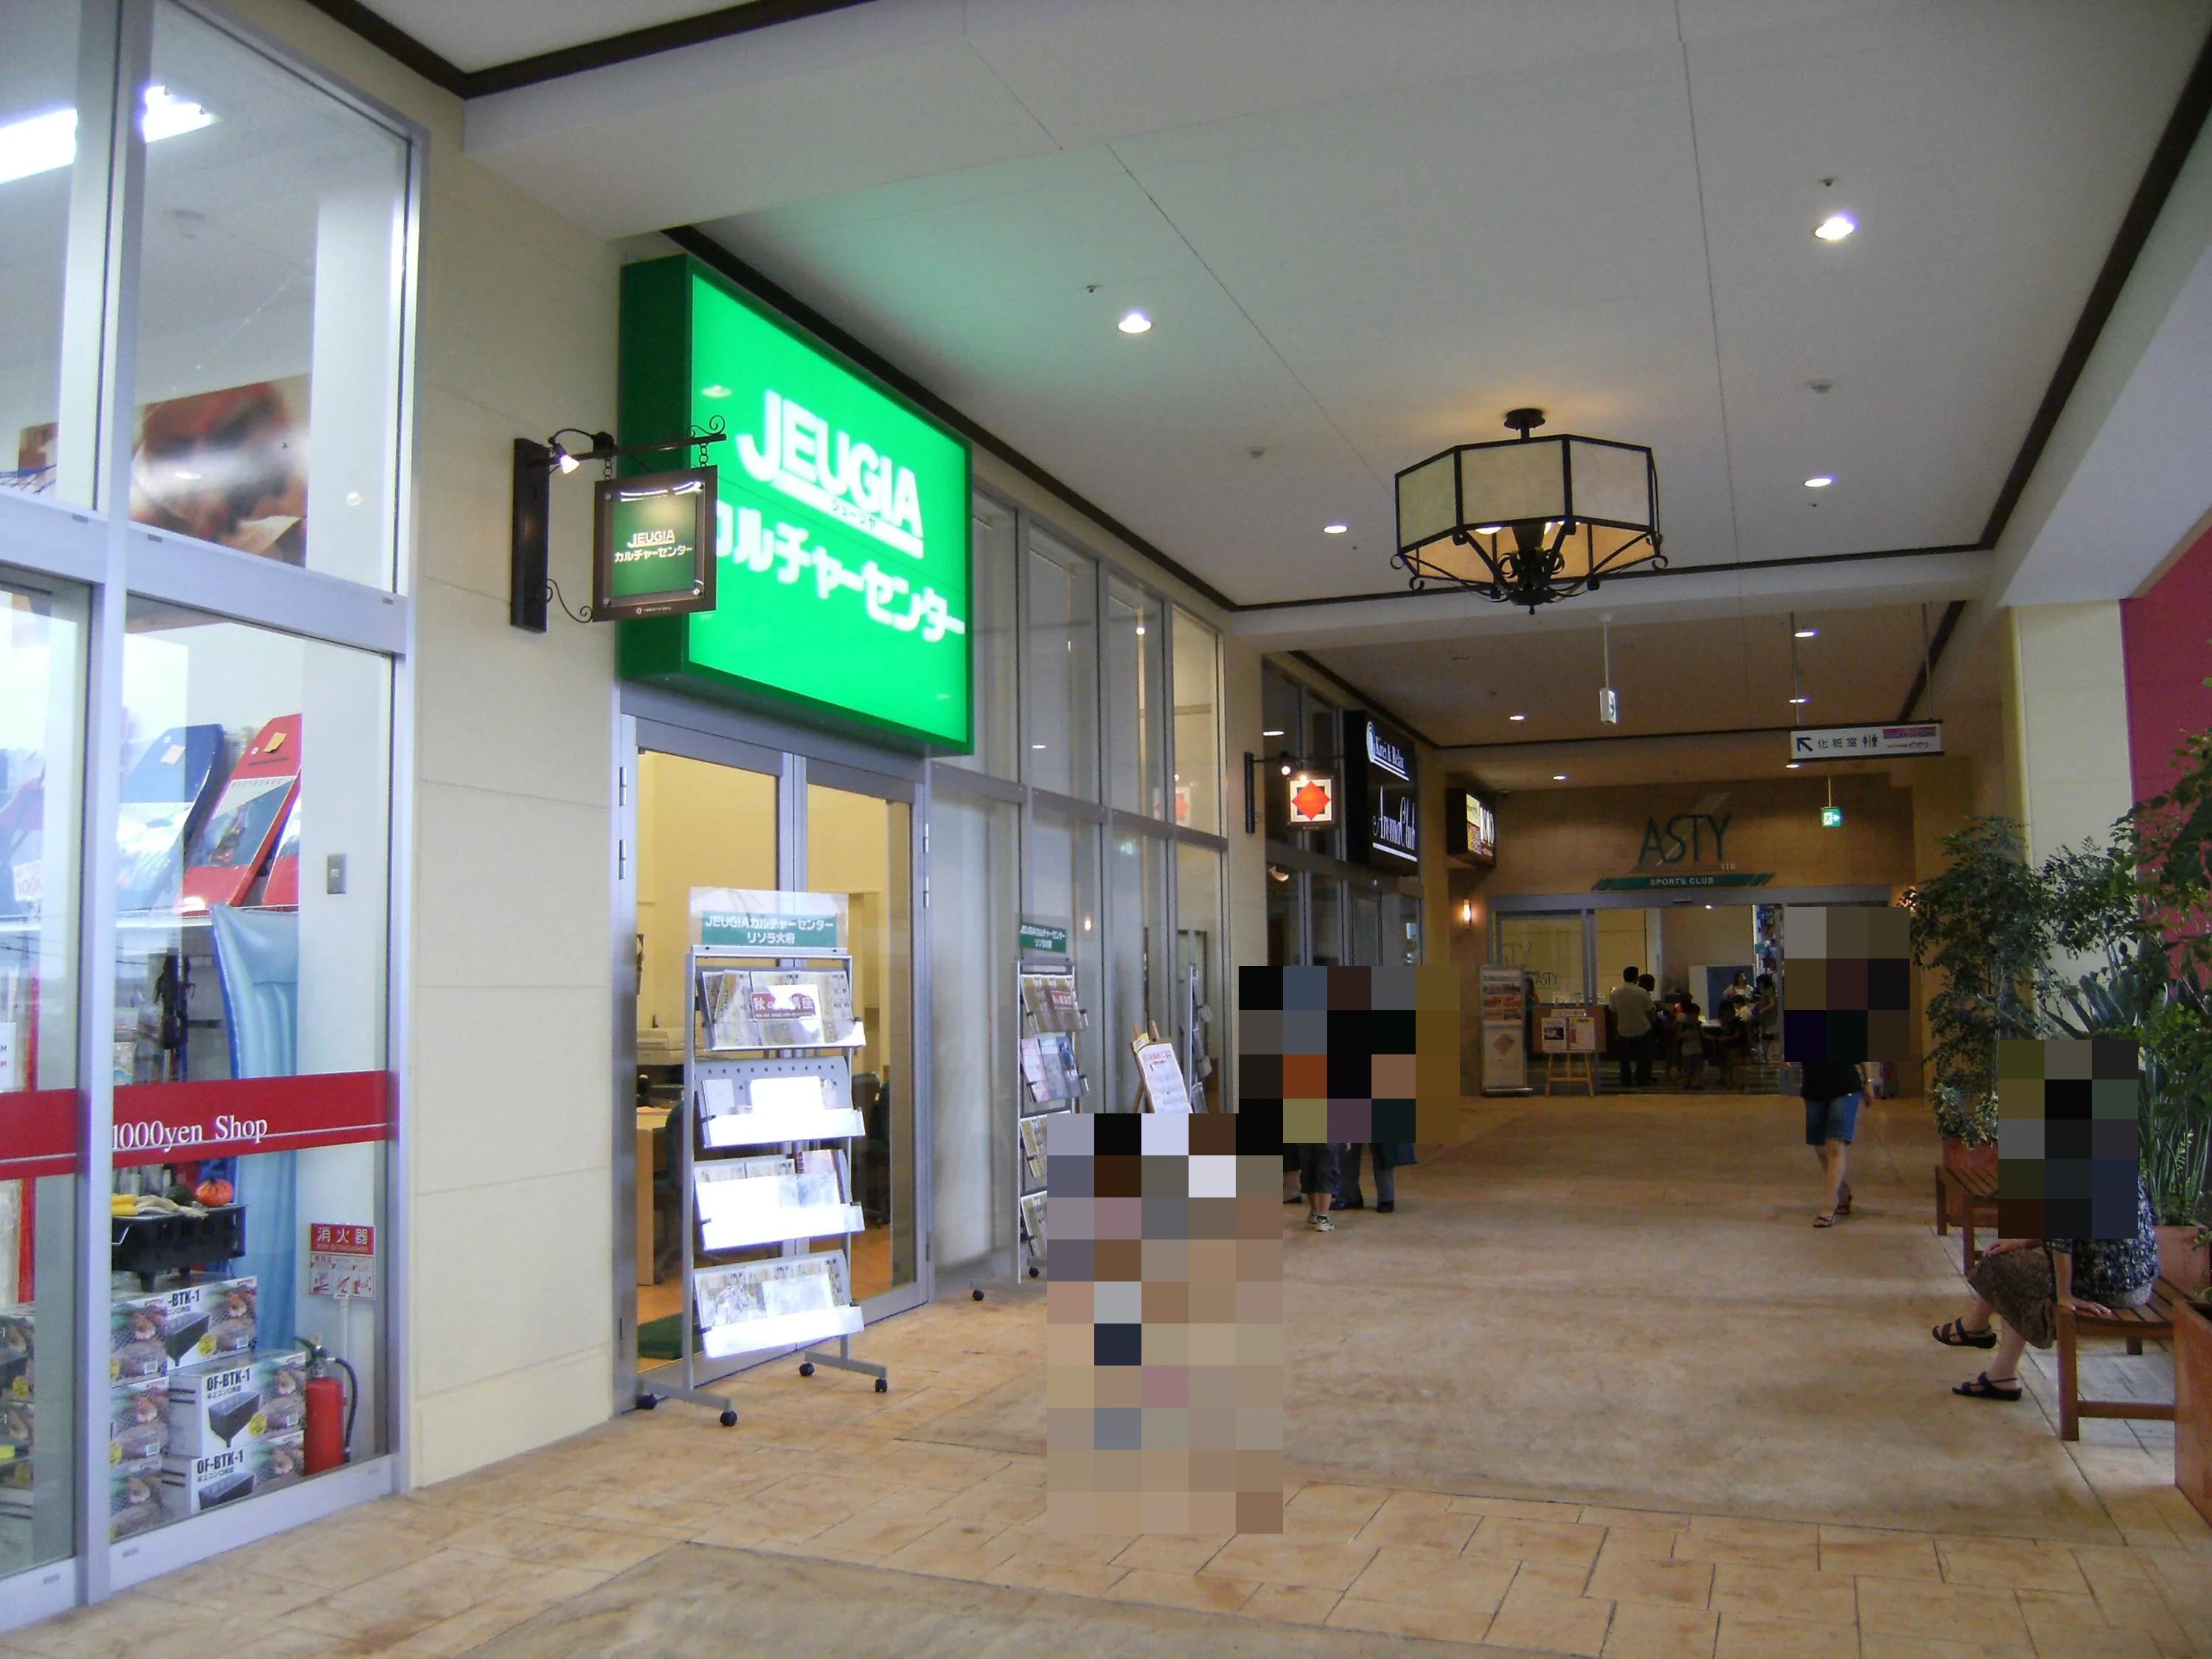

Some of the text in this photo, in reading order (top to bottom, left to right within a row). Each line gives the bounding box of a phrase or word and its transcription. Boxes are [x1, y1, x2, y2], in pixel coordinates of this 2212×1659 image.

[736, 390, 923, 542] JEUGIA
[627, 529, 675, 548] JEUGIA
[614, 546, 693, 563] カルチャーセンター
[1817, 737, 1857, 748] 化粧室
[1637, 813, 1733, 866] ASTY
[1649, 877, 1714, 886] SPORTS CLUB
[705, 916, 834, 931] JEUGIAカルチャーセンター
[747, 932, 796, 945] リソラ大府
[1535, 971, 1559, 986] ASTY
[112, 1114, 268, 1152] 1000yen Shop
[318, 1226, 368, 1245] 消火器
[168, 1289, 201, 1307] -BTK-1
[206, 1368, 251, 1391] OF-BTK-1
[197, 1449, 244, 1475] OF-BTK-1
